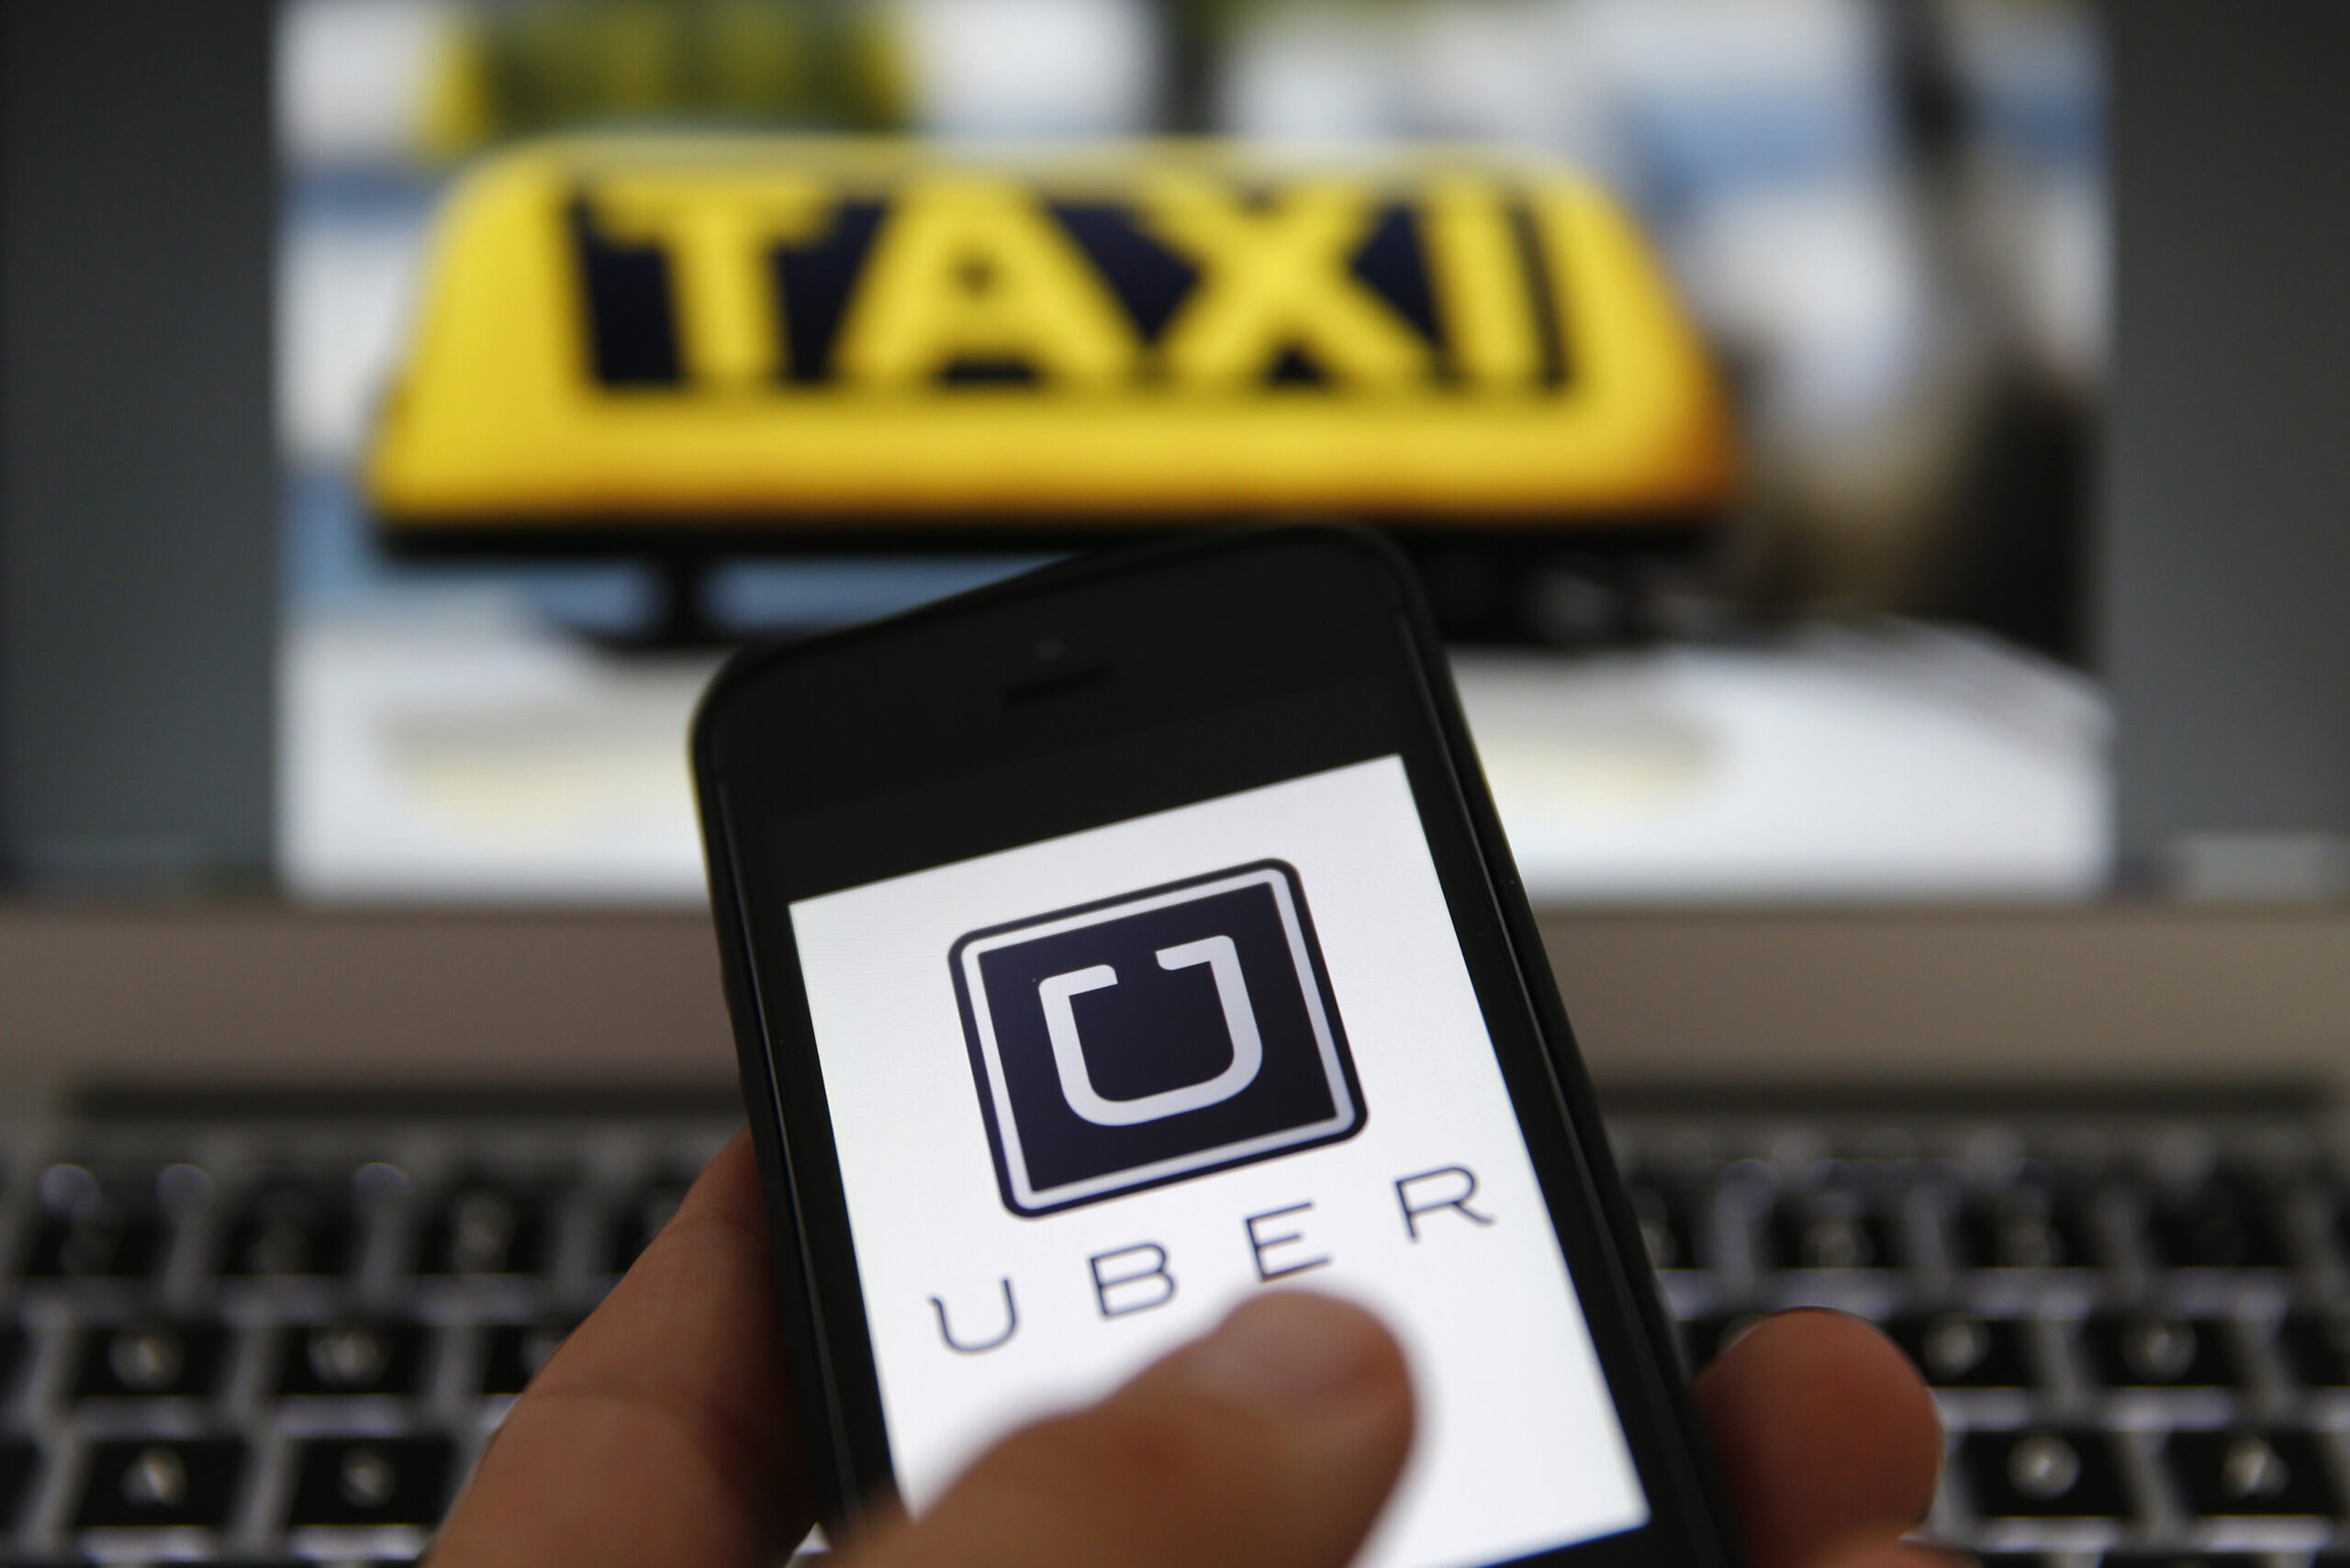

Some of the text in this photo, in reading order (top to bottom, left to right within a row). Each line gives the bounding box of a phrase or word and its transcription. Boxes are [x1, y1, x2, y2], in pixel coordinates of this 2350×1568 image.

[578, 177, 1548, 393] TAXI
[1037, 934, 1263, 1127] U
[927, 1163, 1496, 1355] UBER
